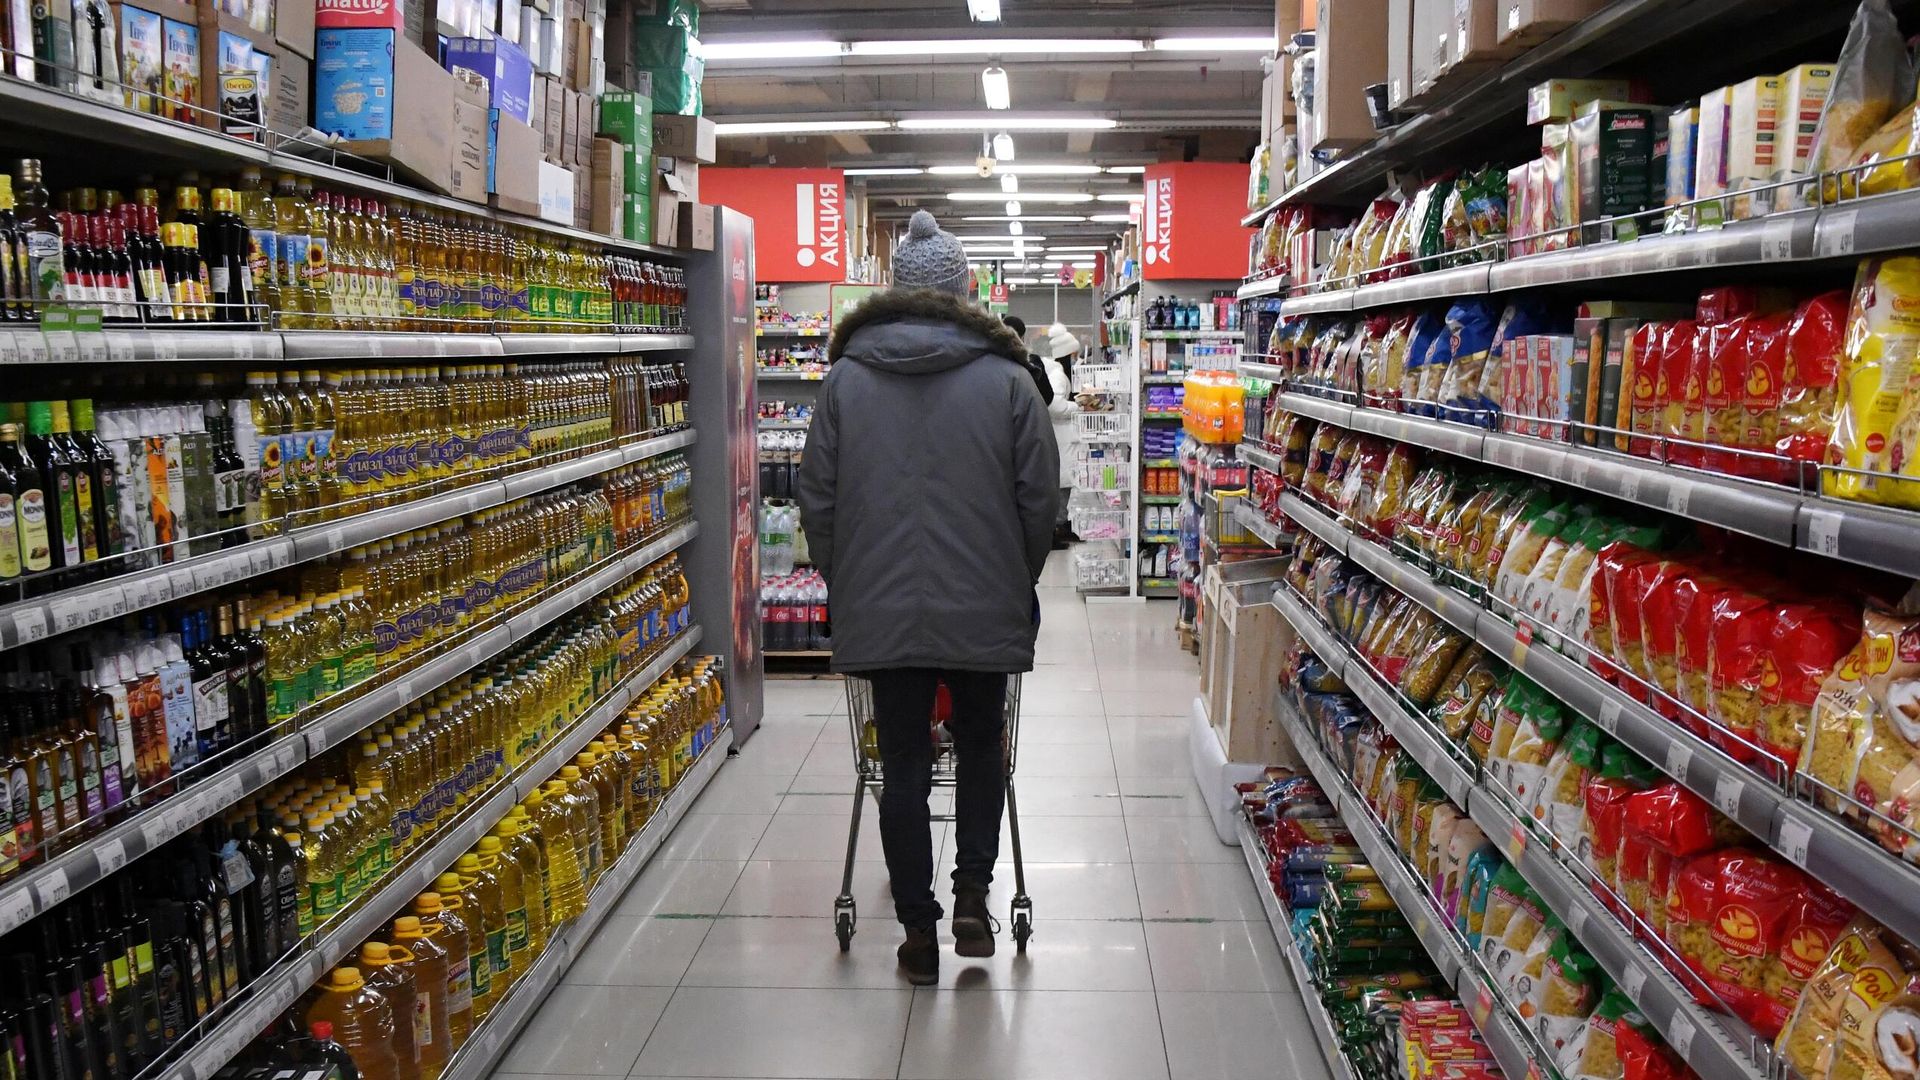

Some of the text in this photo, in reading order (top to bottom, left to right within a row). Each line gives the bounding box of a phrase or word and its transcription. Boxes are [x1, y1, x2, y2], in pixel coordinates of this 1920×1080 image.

[226, 80, 253, 91] Iberica
[819, 183, 842, 266] АКЦИЯ
[1158, 178, 1173, 264] АКЦИЯ
